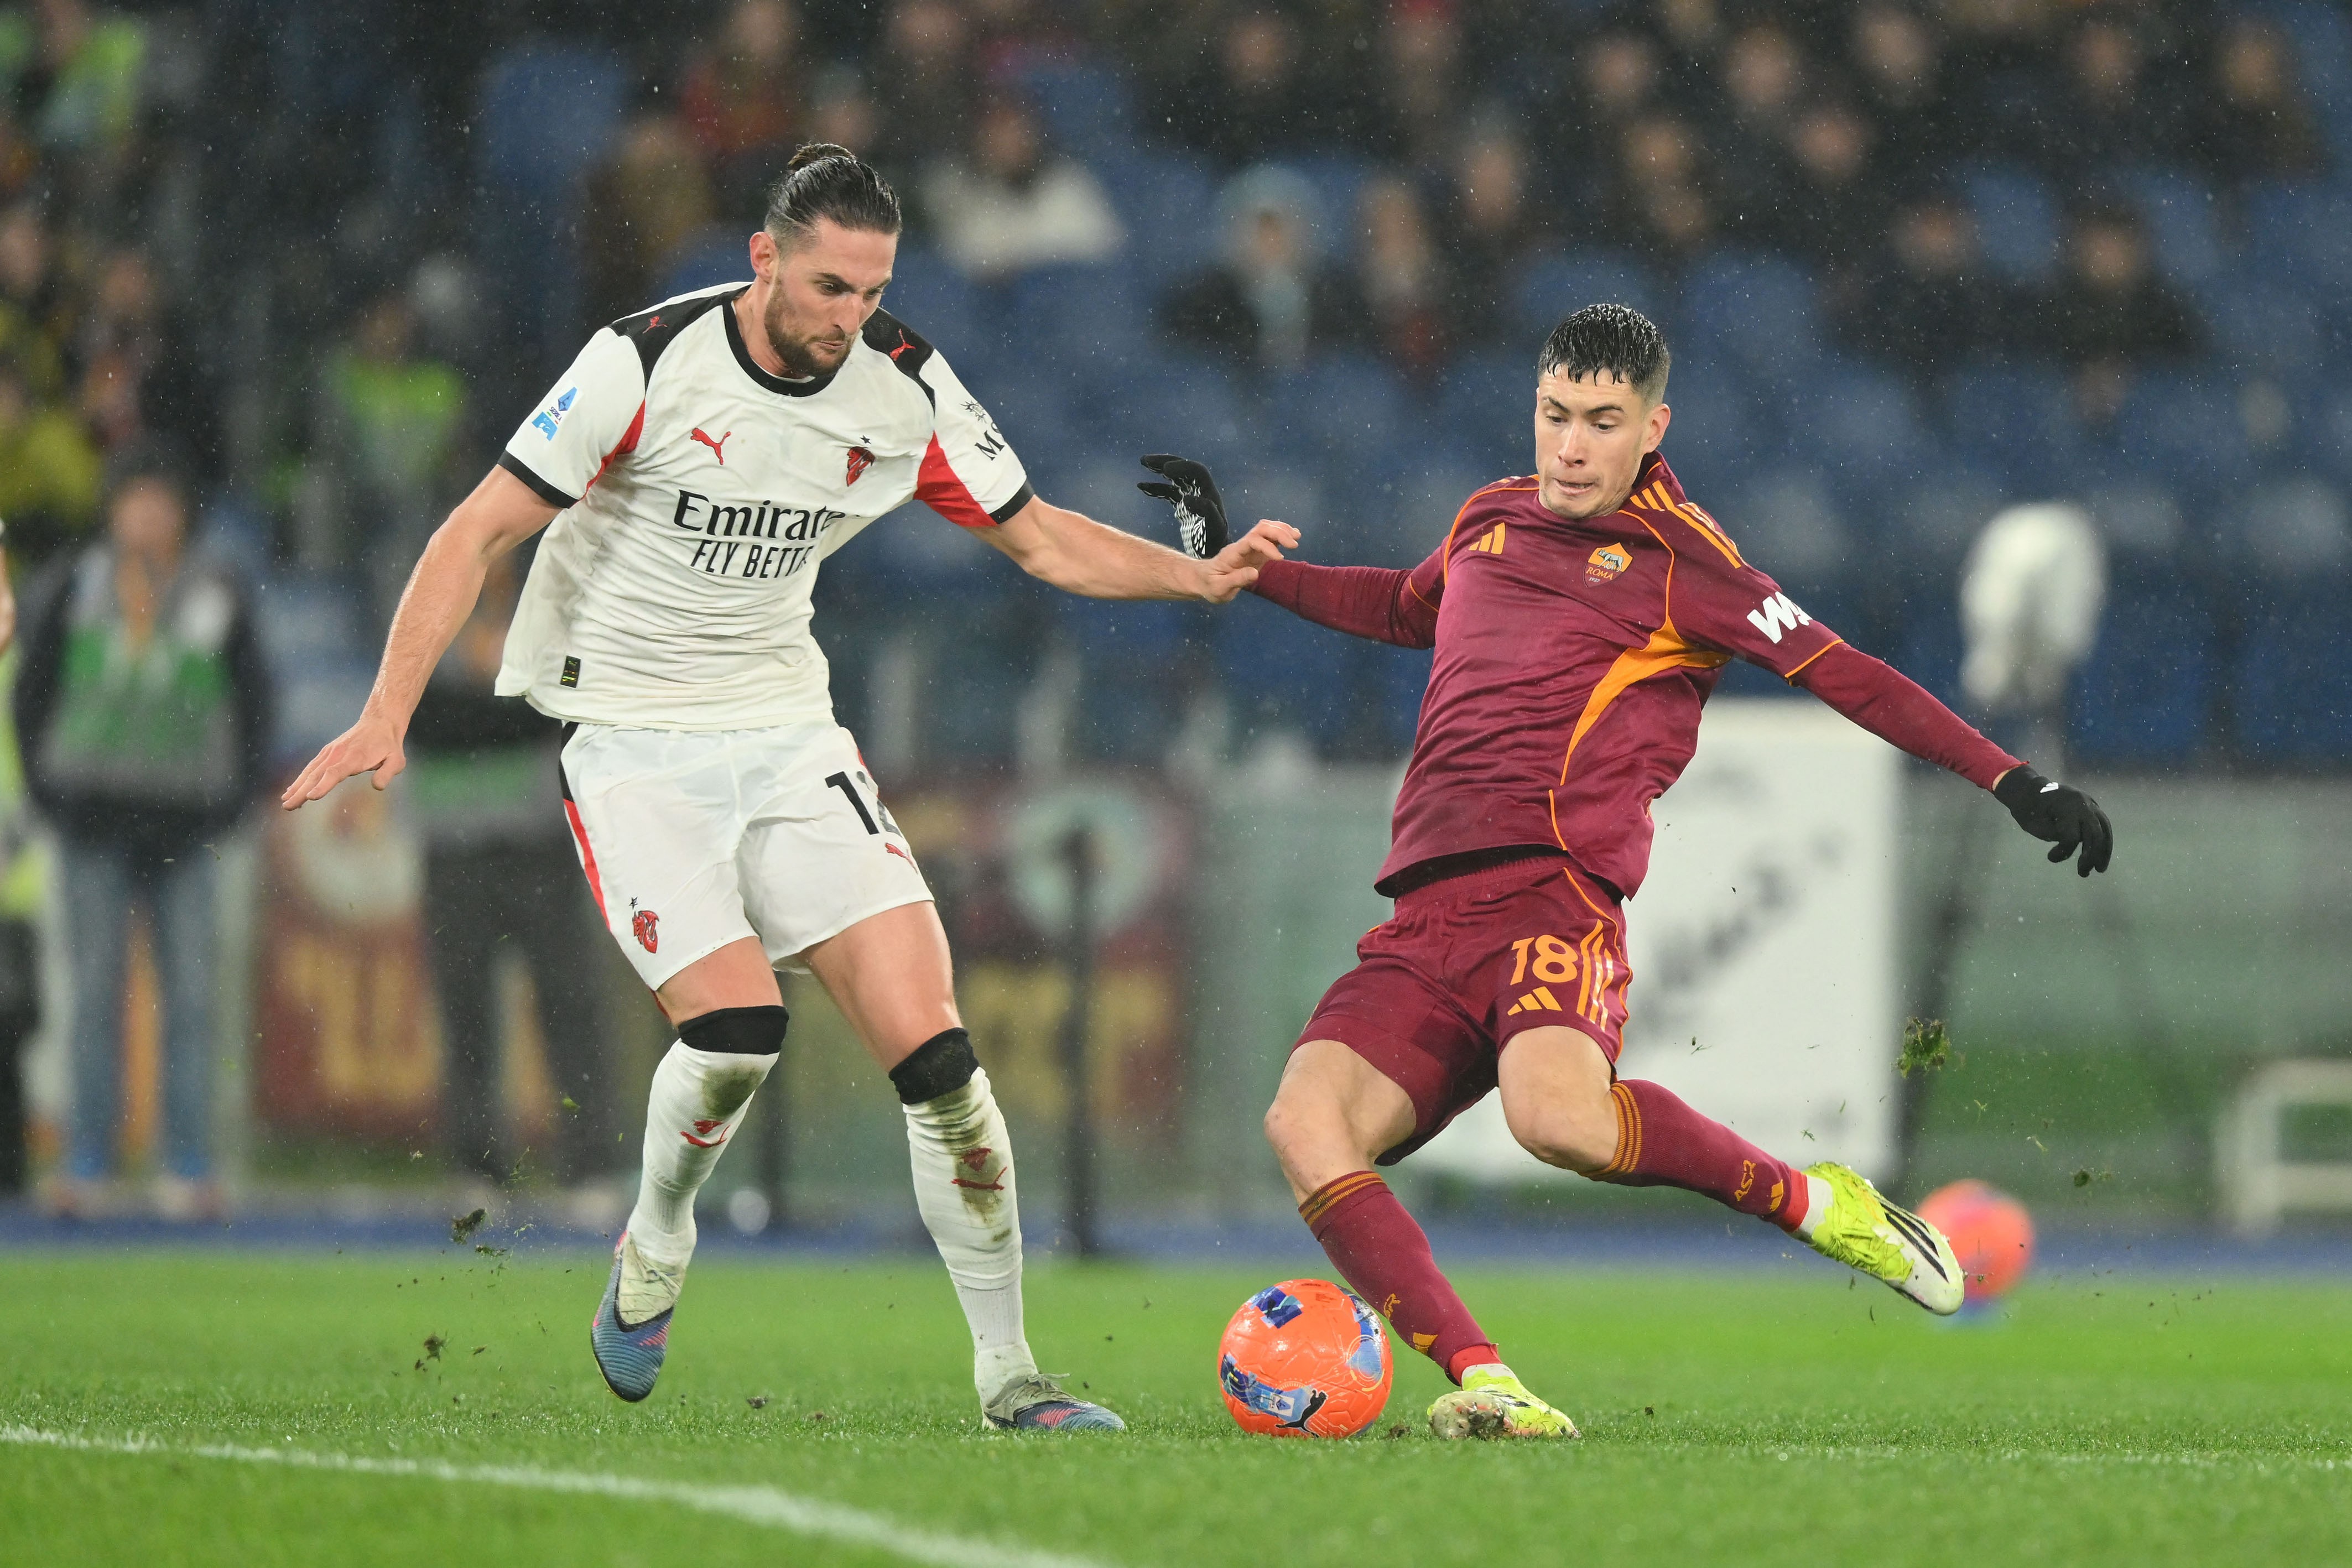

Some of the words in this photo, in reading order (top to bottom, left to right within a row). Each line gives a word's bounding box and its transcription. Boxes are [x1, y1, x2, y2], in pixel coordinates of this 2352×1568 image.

[674, 489, 846, 540] Emirate
[691, 539, 740, 575] FLY
[742, 544, 815, 579] BETTE
[1586, 566, 1614, 580] ROMA
[1510, 934, 1578, 986] 18
